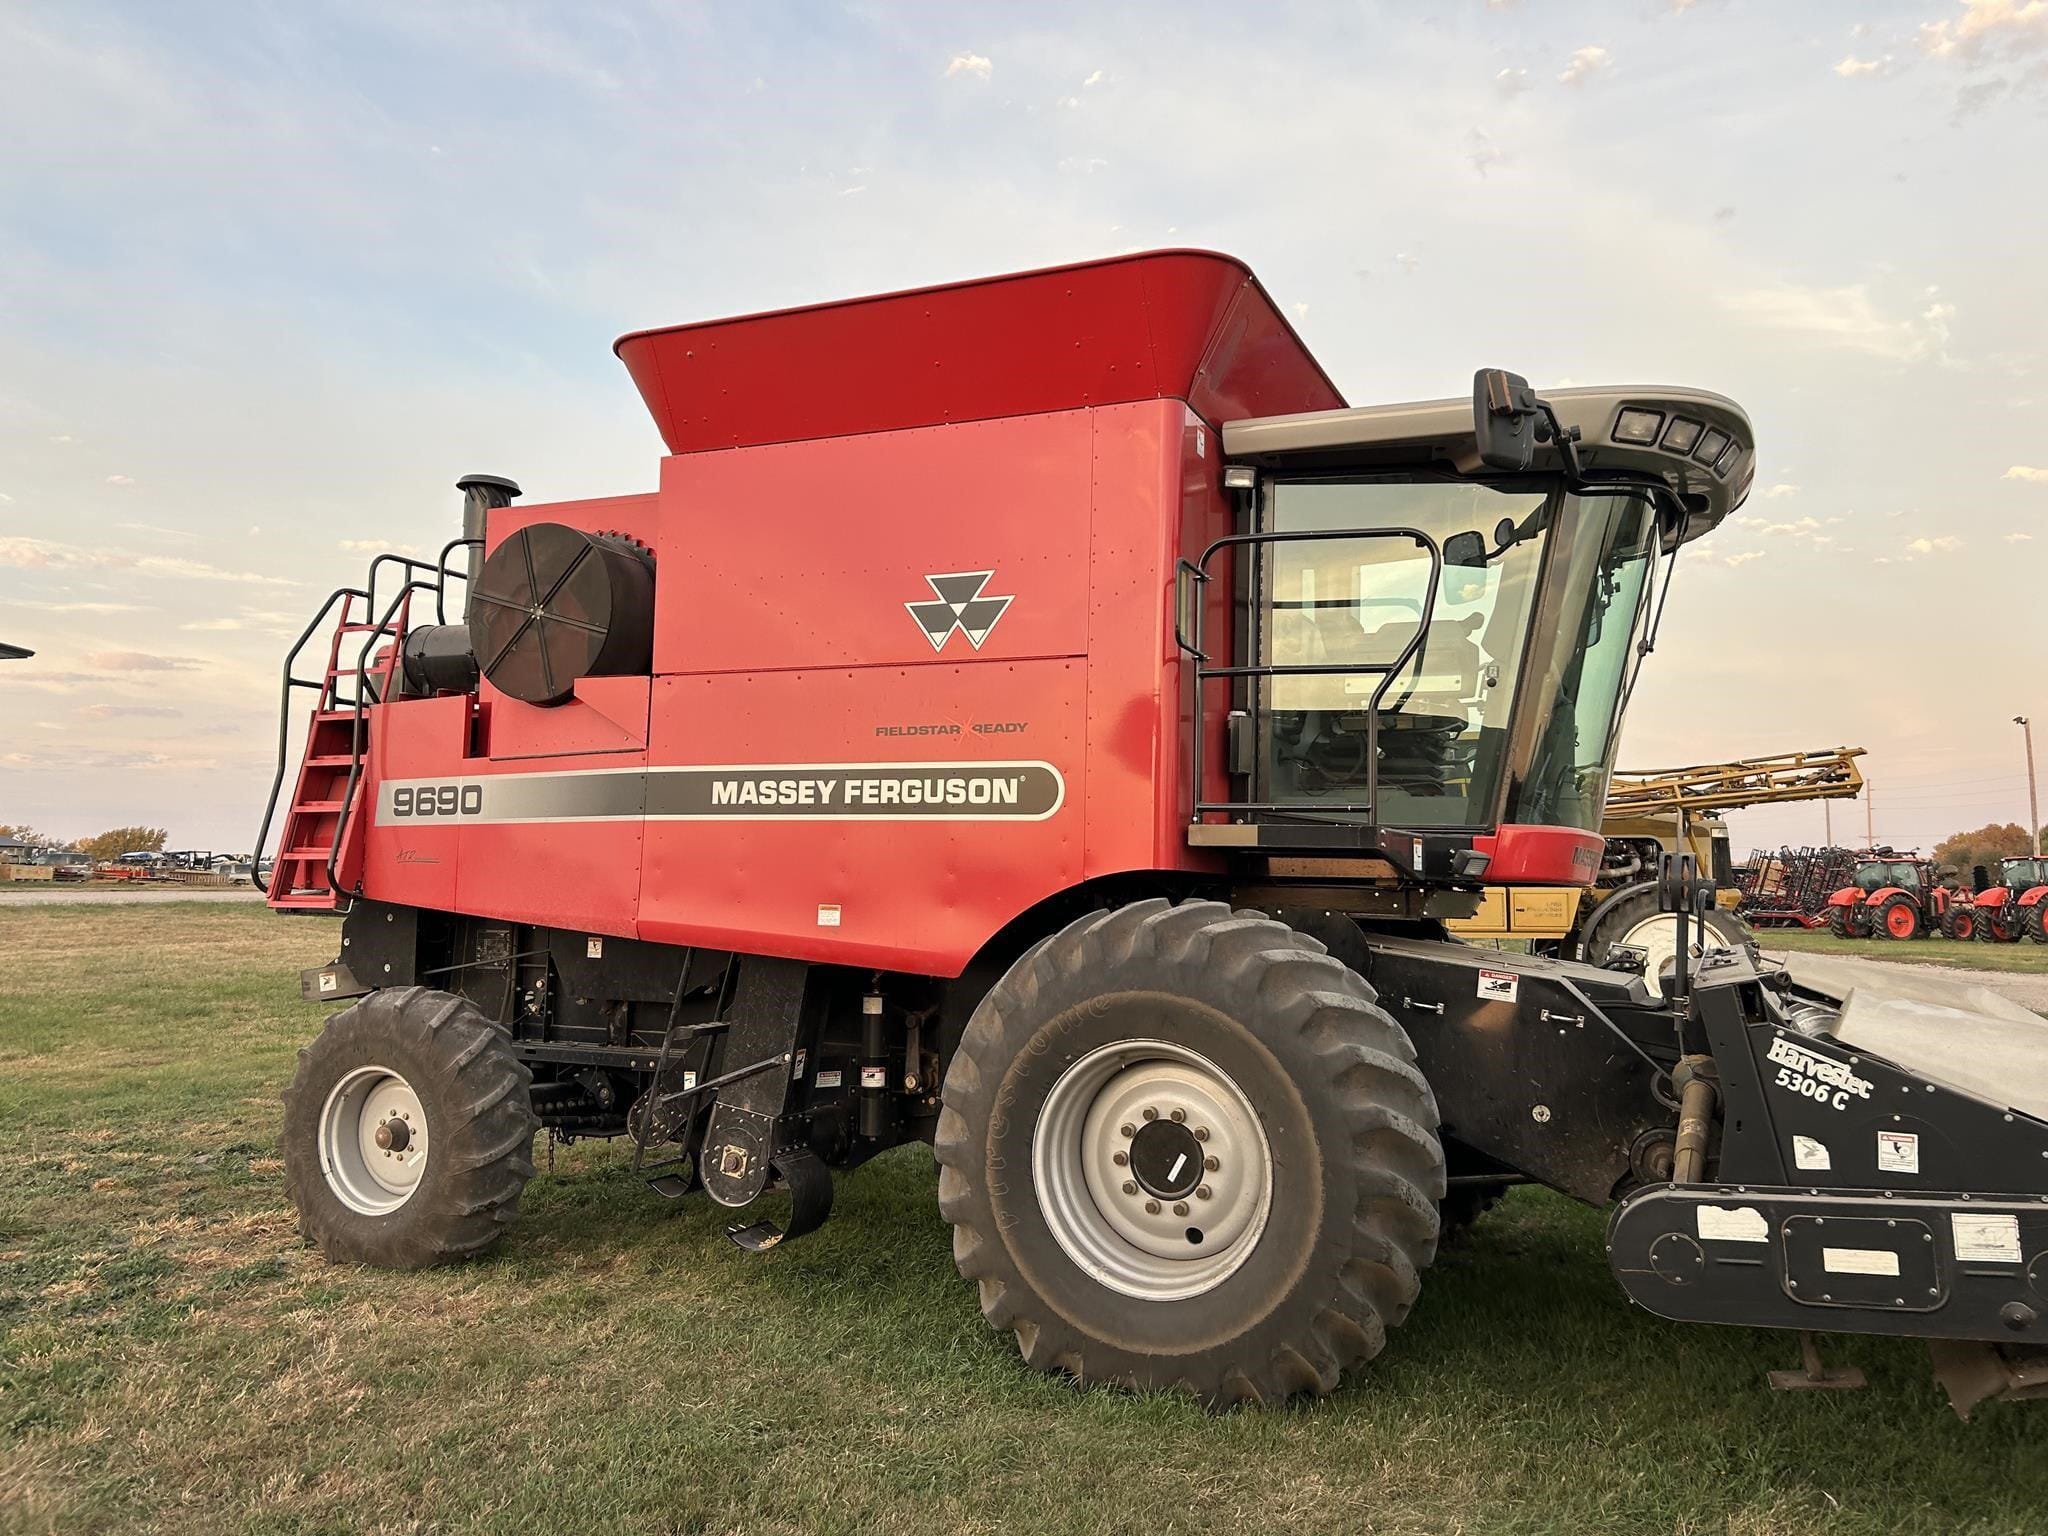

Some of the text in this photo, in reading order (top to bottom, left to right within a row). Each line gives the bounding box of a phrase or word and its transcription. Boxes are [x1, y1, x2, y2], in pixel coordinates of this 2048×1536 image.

[875, 722, 1028, 737] FIELDSTAR READY
[393, 784, 483, 817] 9690
[711, 778, 1018, 805] MASSEY FERGUSON
[1766, 1036, 1875, 1099] Harvestec
[1774, 1067, 1850, 1111] 5306 C
